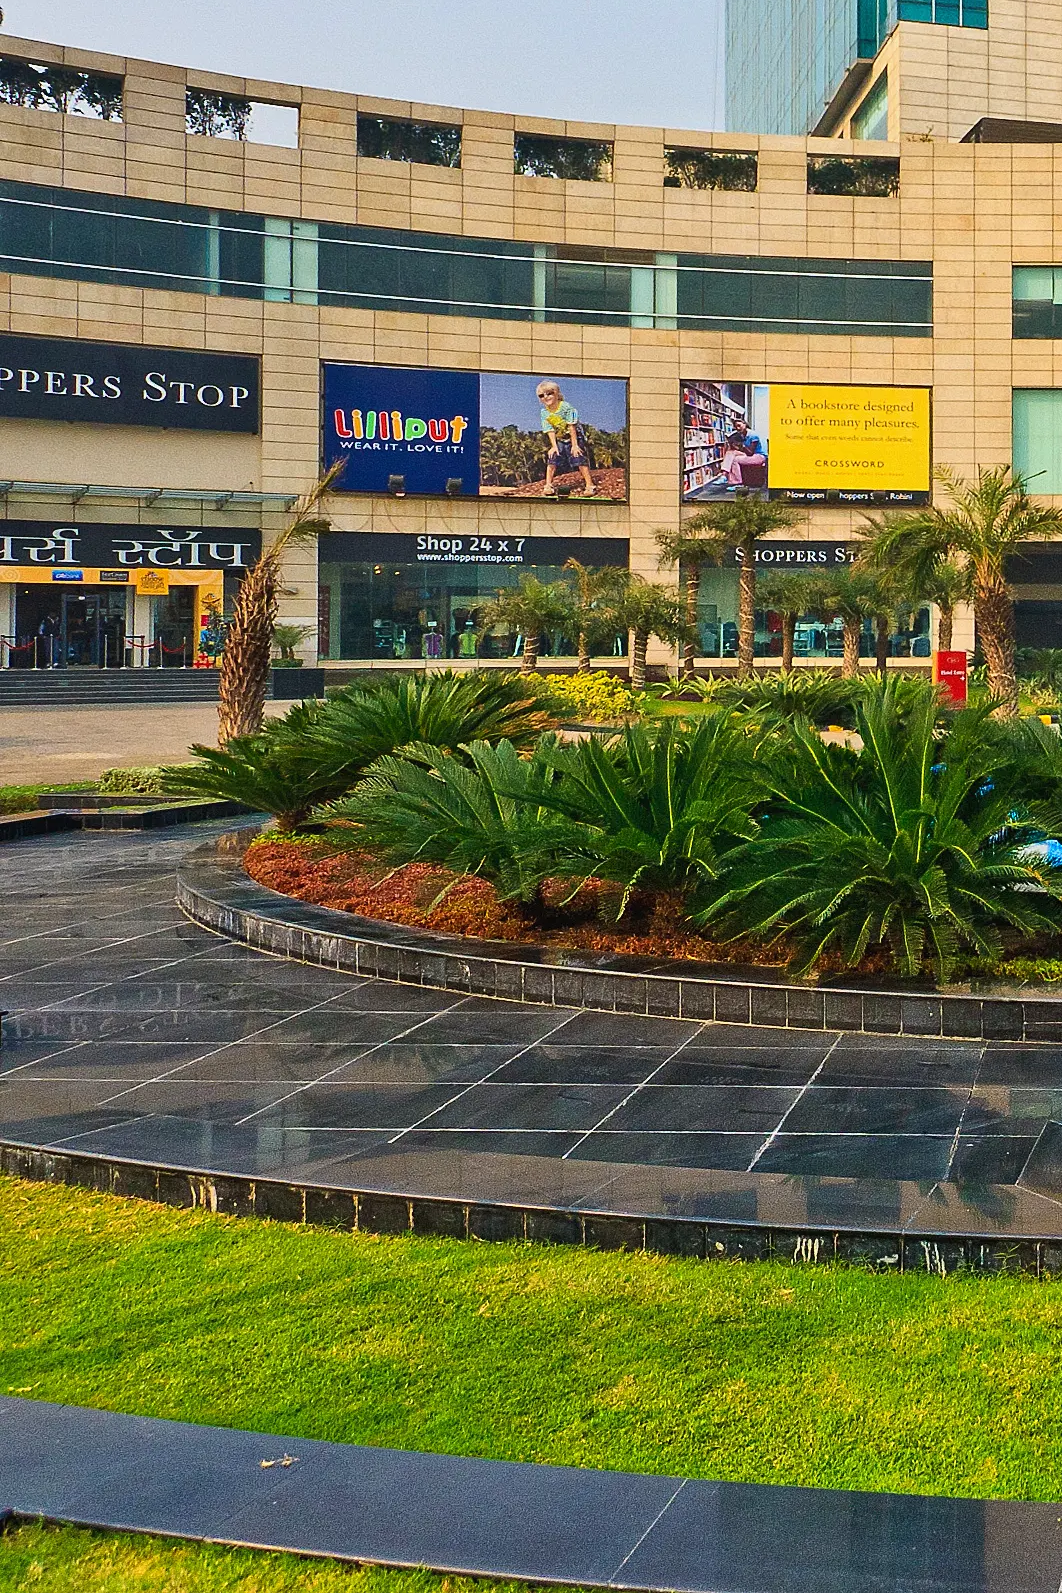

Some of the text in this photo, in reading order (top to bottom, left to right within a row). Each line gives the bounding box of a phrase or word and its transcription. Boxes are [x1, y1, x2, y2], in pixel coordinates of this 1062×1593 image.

[0, 368, 250, 408] PPERS STOP
[787, 398, 915, 415] A bookstore designed
[334, 408, 468, 442] Lilliput
[780, 415, 919, 430] to offer many pleasures.
[340, 441, 465, 454] WEAR IT. LOVE IT!
[814, 459, 885, 469] CROSSWORD
[786, 490, 805, 499] Now
[839, 491, 868, 501] hoppers
[111, 529, 252, 567] स्टॉप
[416, 535, 526, 554] Shop 24 x 7
[416, 553, 524, 564] www.shoppersstop.com
